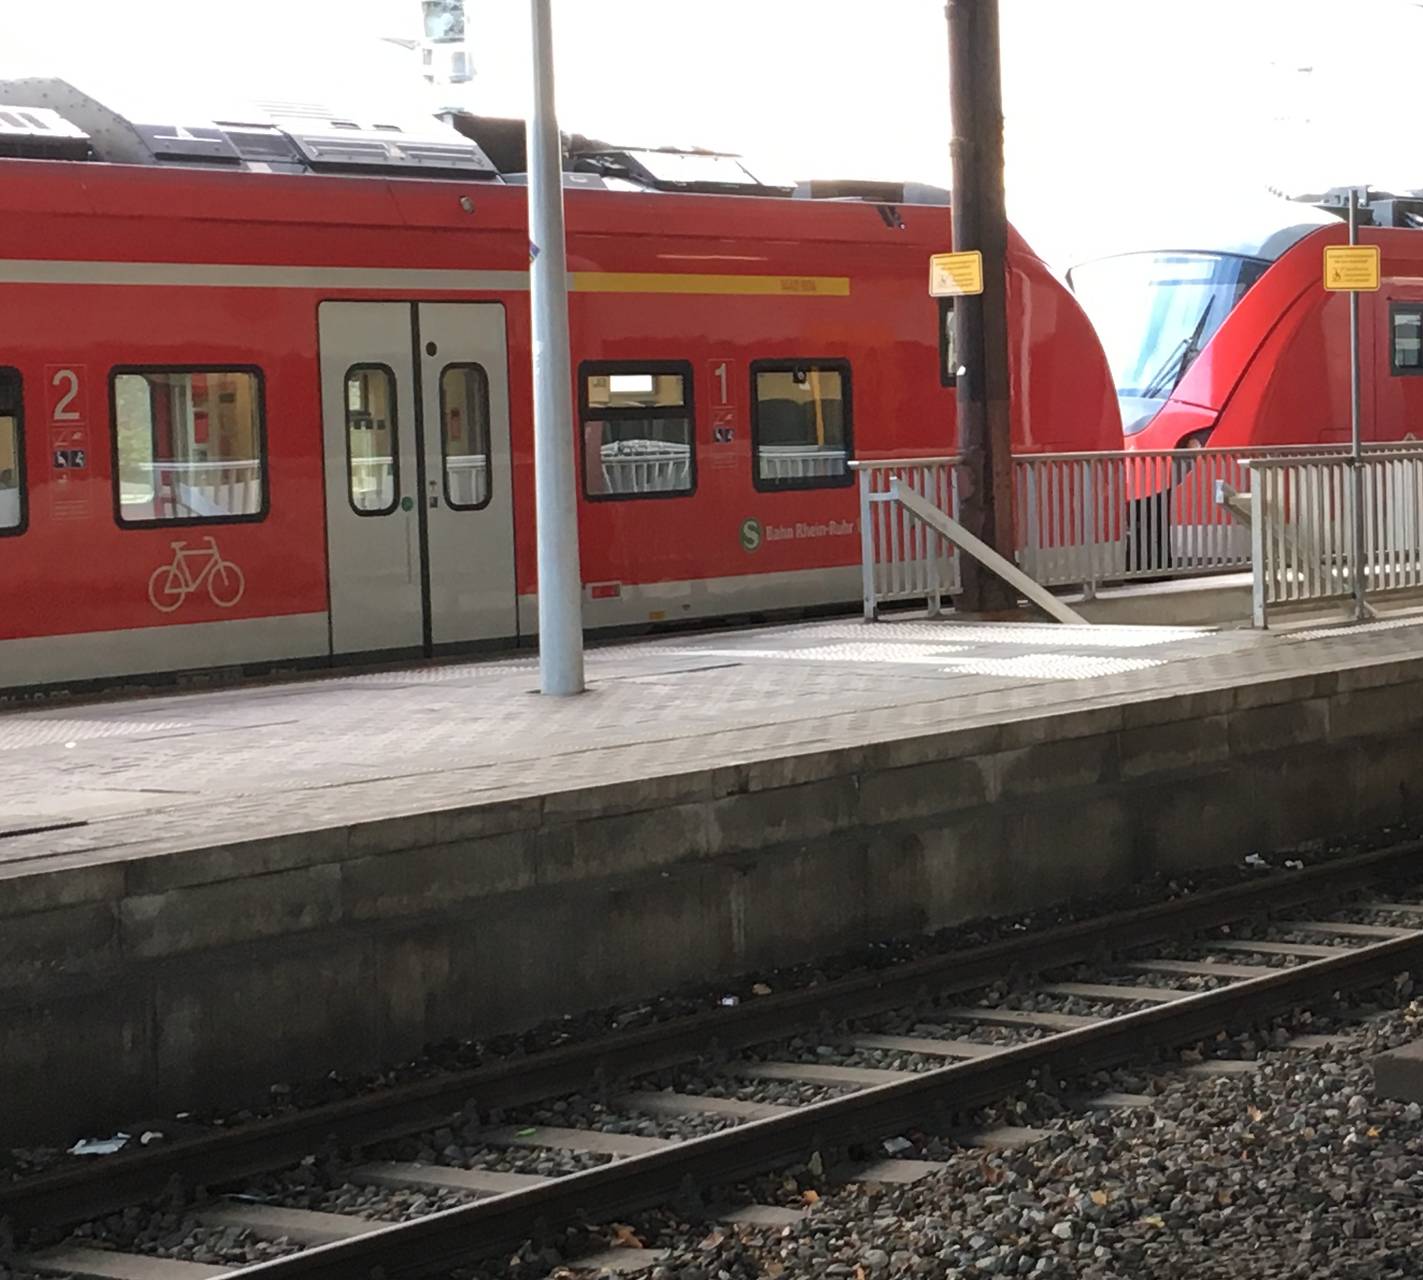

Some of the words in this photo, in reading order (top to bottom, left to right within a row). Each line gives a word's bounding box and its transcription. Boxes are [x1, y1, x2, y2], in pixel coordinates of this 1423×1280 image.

[52, 369, 81, 421] 2
[714, 362, 728, 405] 1
[742, 520, 761, 550] S
[766, 525, 794, 541] Bahn
[795, 519, 854, 539] Rhein-Ruhr
